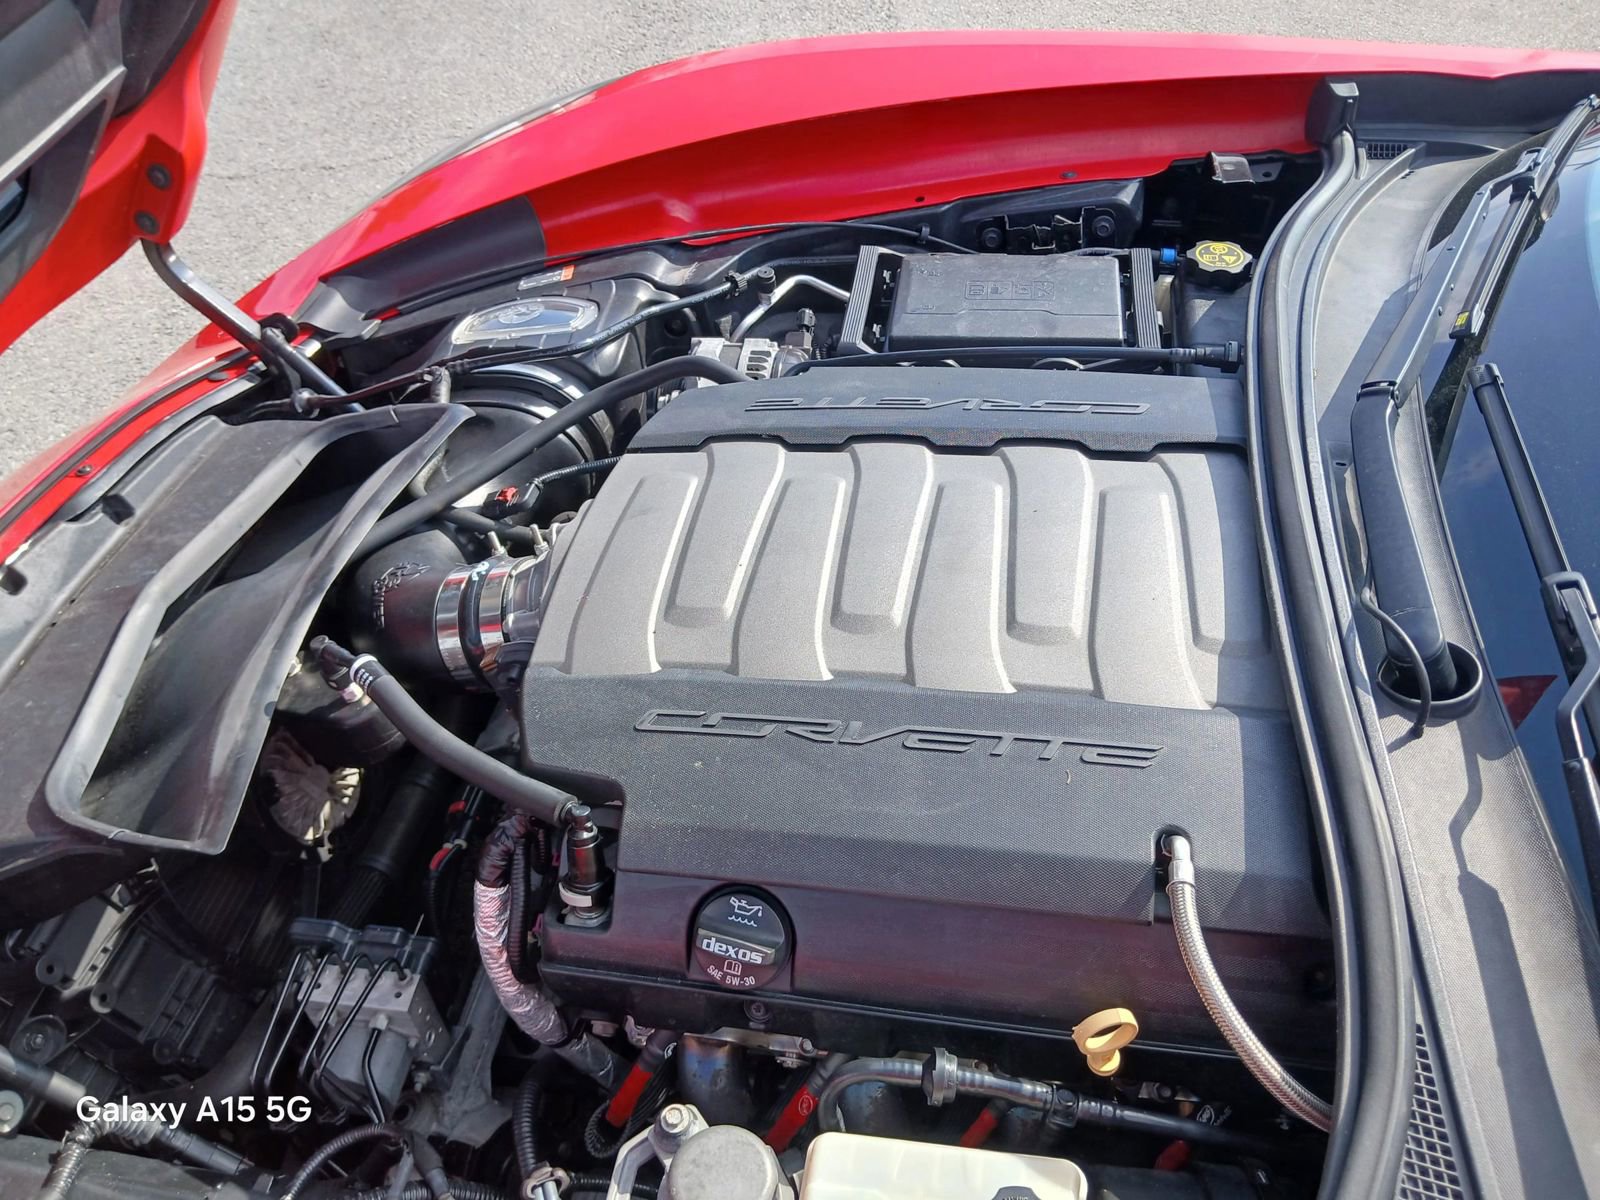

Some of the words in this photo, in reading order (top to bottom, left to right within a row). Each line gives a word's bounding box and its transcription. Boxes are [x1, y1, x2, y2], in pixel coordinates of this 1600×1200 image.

[634, 708, 1165, 769] CORVETTE
[701, 936, 766, 965] dexos
[706, 964, 724, 981] SAE
[725, 975, 756, 987] 5W-30
